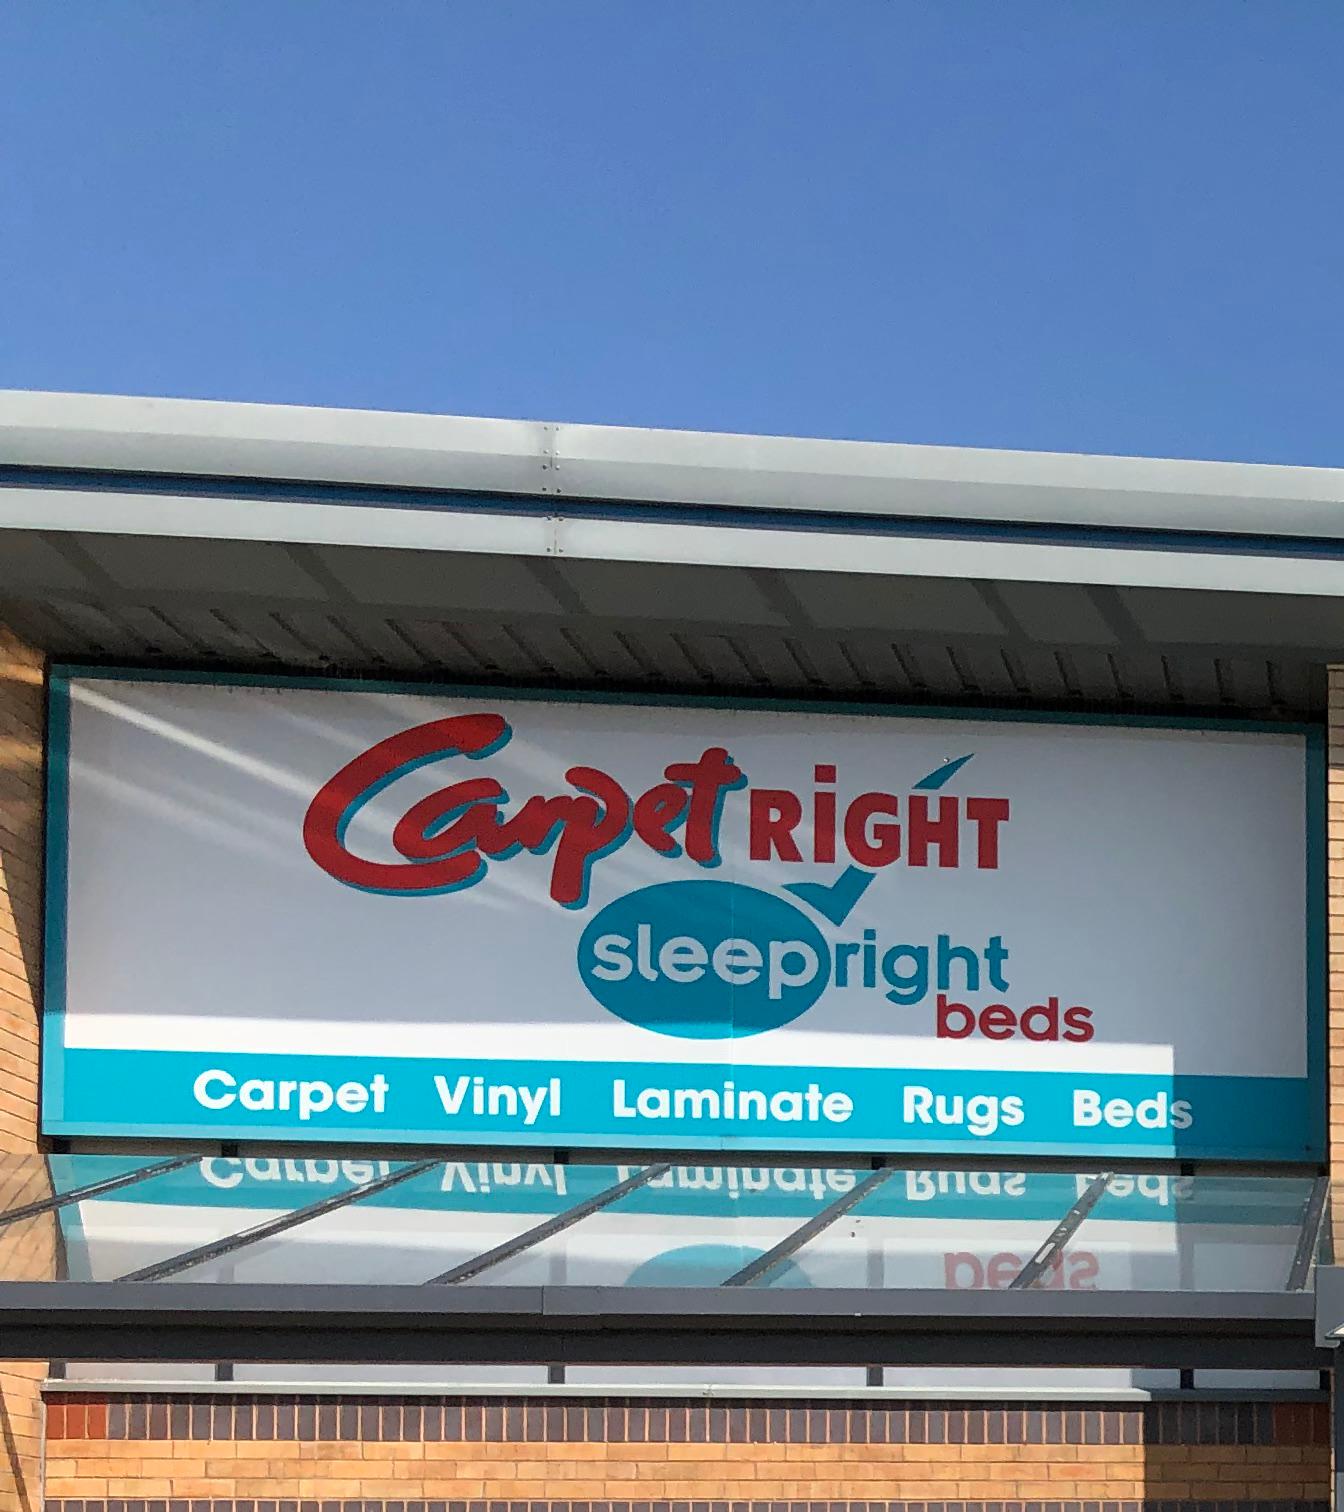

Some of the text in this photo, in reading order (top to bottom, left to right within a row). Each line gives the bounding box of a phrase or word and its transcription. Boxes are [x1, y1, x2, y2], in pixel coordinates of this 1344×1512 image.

[936, 994, 1095, 1042] beds
[194, 1069, 1193, 1136] Carpet Vinyl Laminate Rugs Beds
